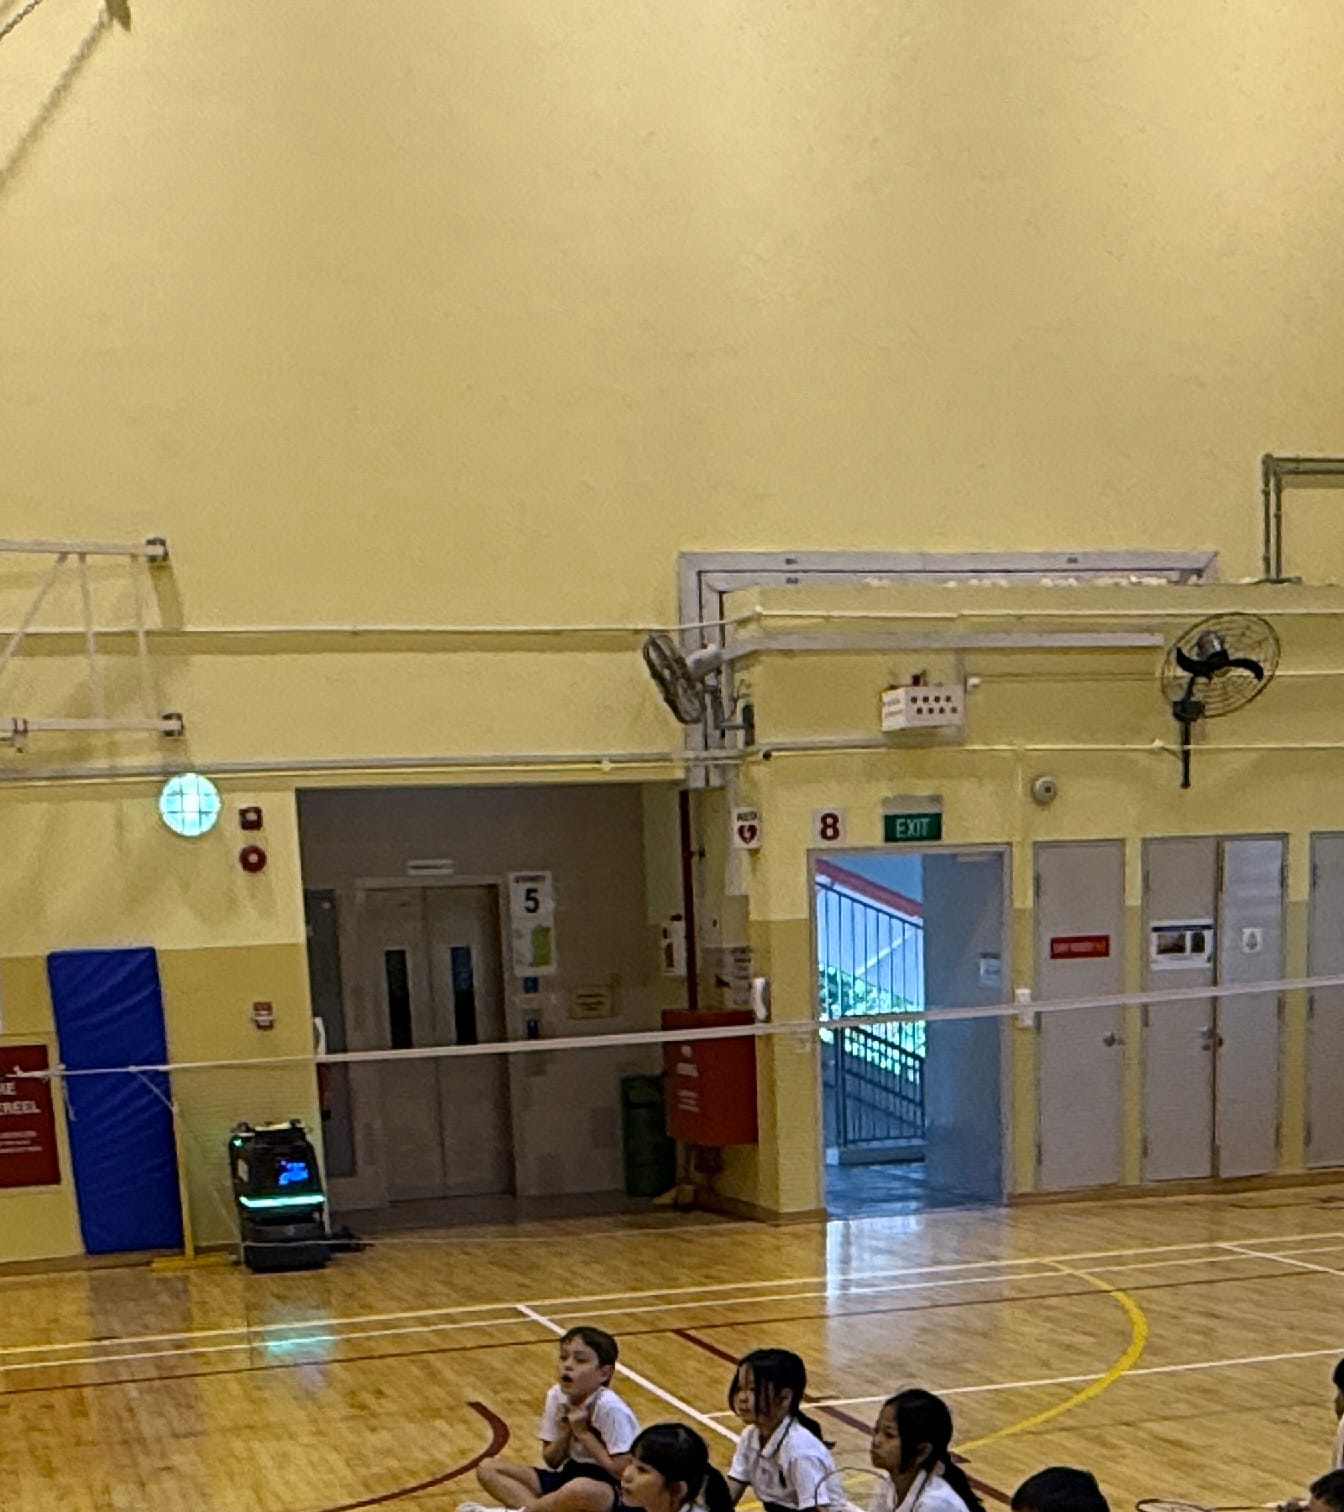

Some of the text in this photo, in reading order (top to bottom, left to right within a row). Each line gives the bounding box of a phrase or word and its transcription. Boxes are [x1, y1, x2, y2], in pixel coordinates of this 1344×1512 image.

[820, 812, 840, 841] 8
[895, 818, 931, 838] EXIT
[524, 888, 539, 914] 5
